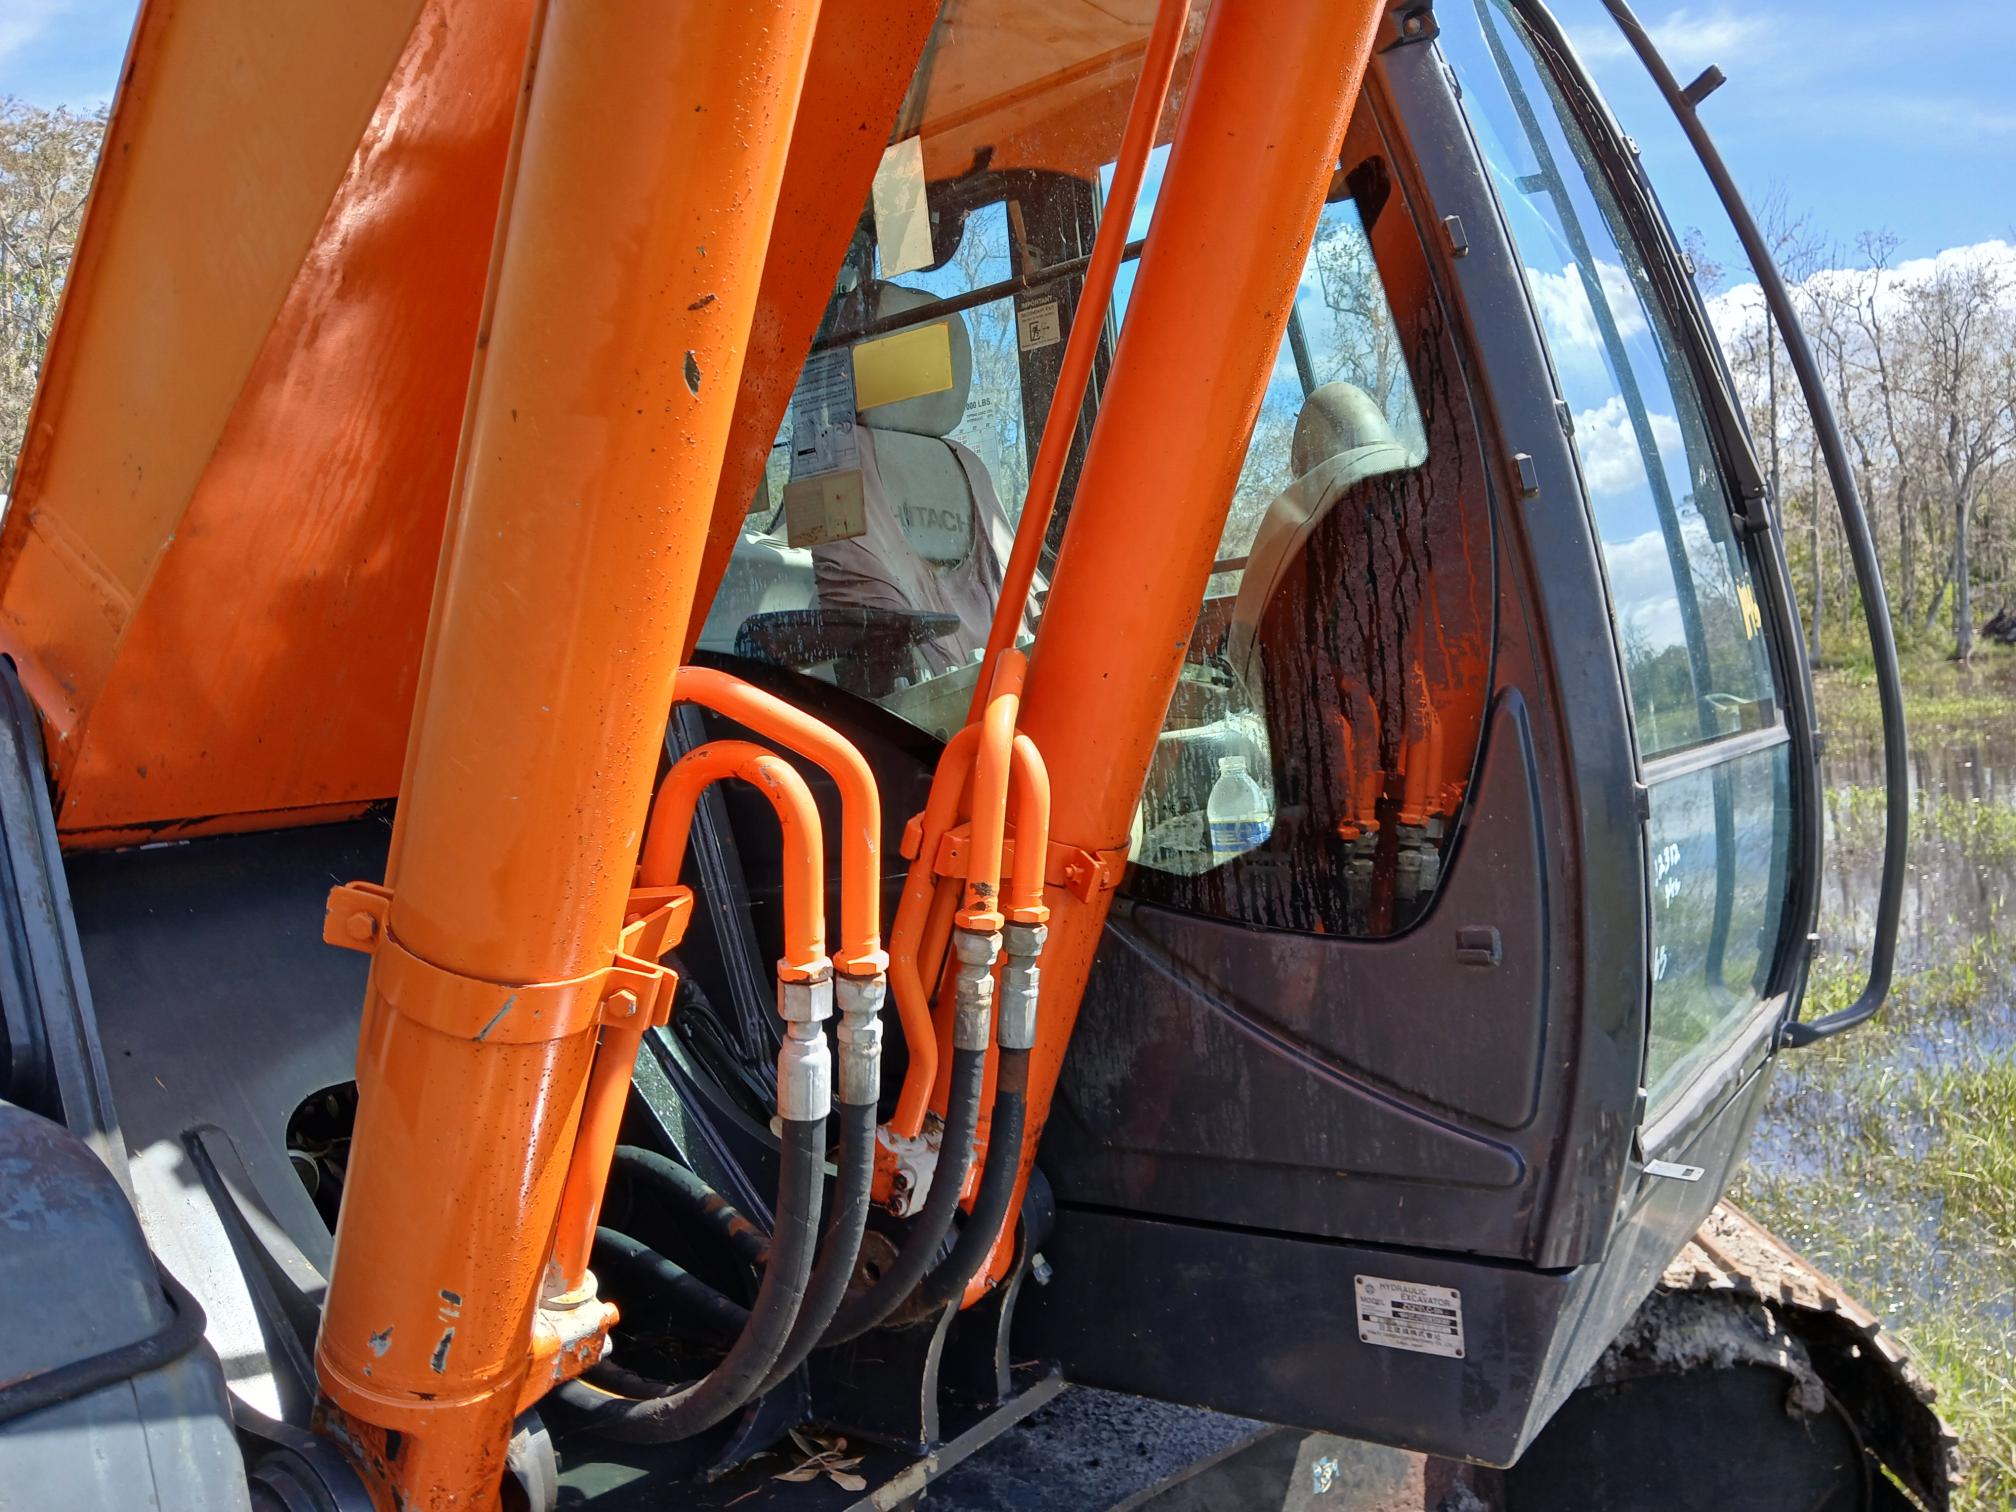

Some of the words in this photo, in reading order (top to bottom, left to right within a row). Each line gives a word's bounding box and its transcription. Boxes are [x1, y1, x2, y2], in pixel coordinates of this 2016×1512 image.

[1379, 1283, 1427, 1295] HYDRAULIC
[1360, 1297, 1385, 1306] MODEL
[1401, 1293, 1450, 1306] EXCAVATOR
